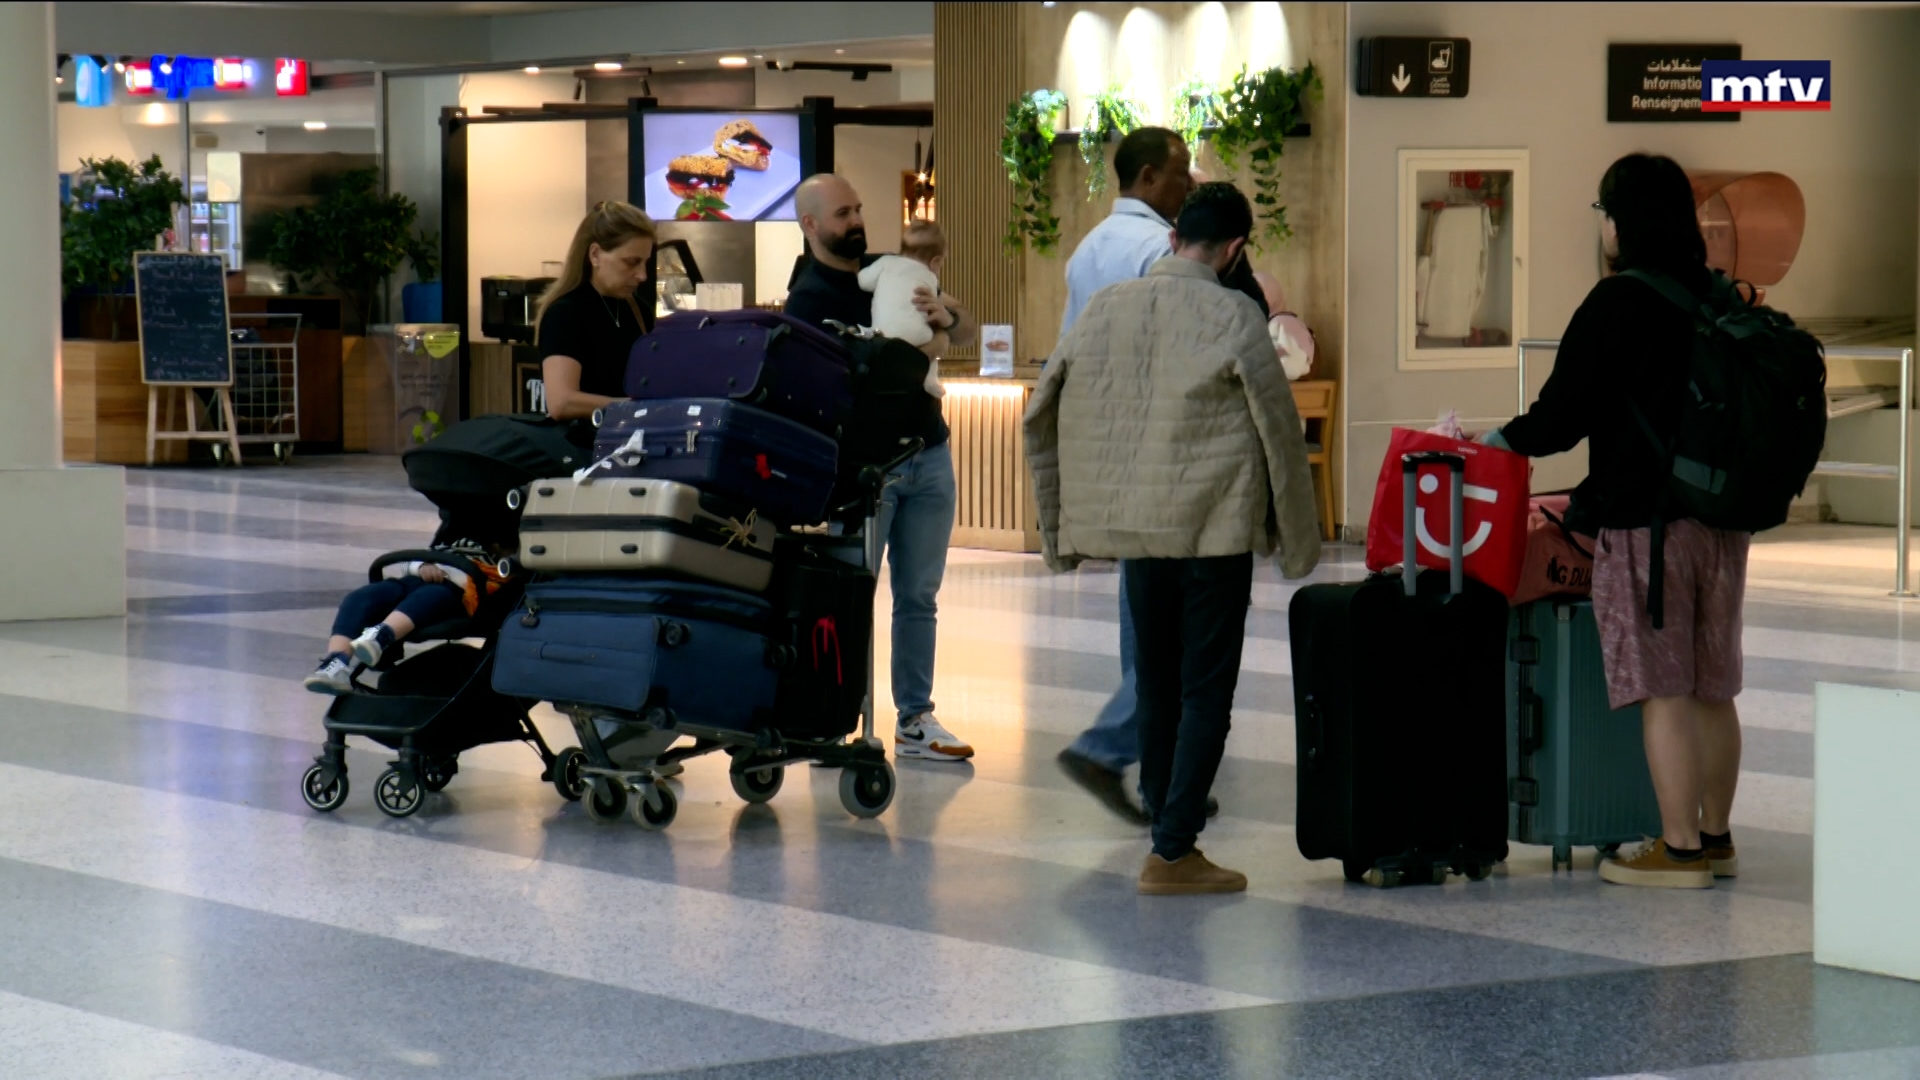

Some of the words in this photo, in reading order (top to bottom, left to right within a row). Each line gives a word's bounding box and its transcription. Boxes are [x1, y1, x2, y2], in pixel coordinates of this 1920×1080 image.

[1647, 58, 1702, 72] ستعلامات
[1643, 76, 1702, 90] Informatio
[1632, 94, 1702, 112] Renseignem
